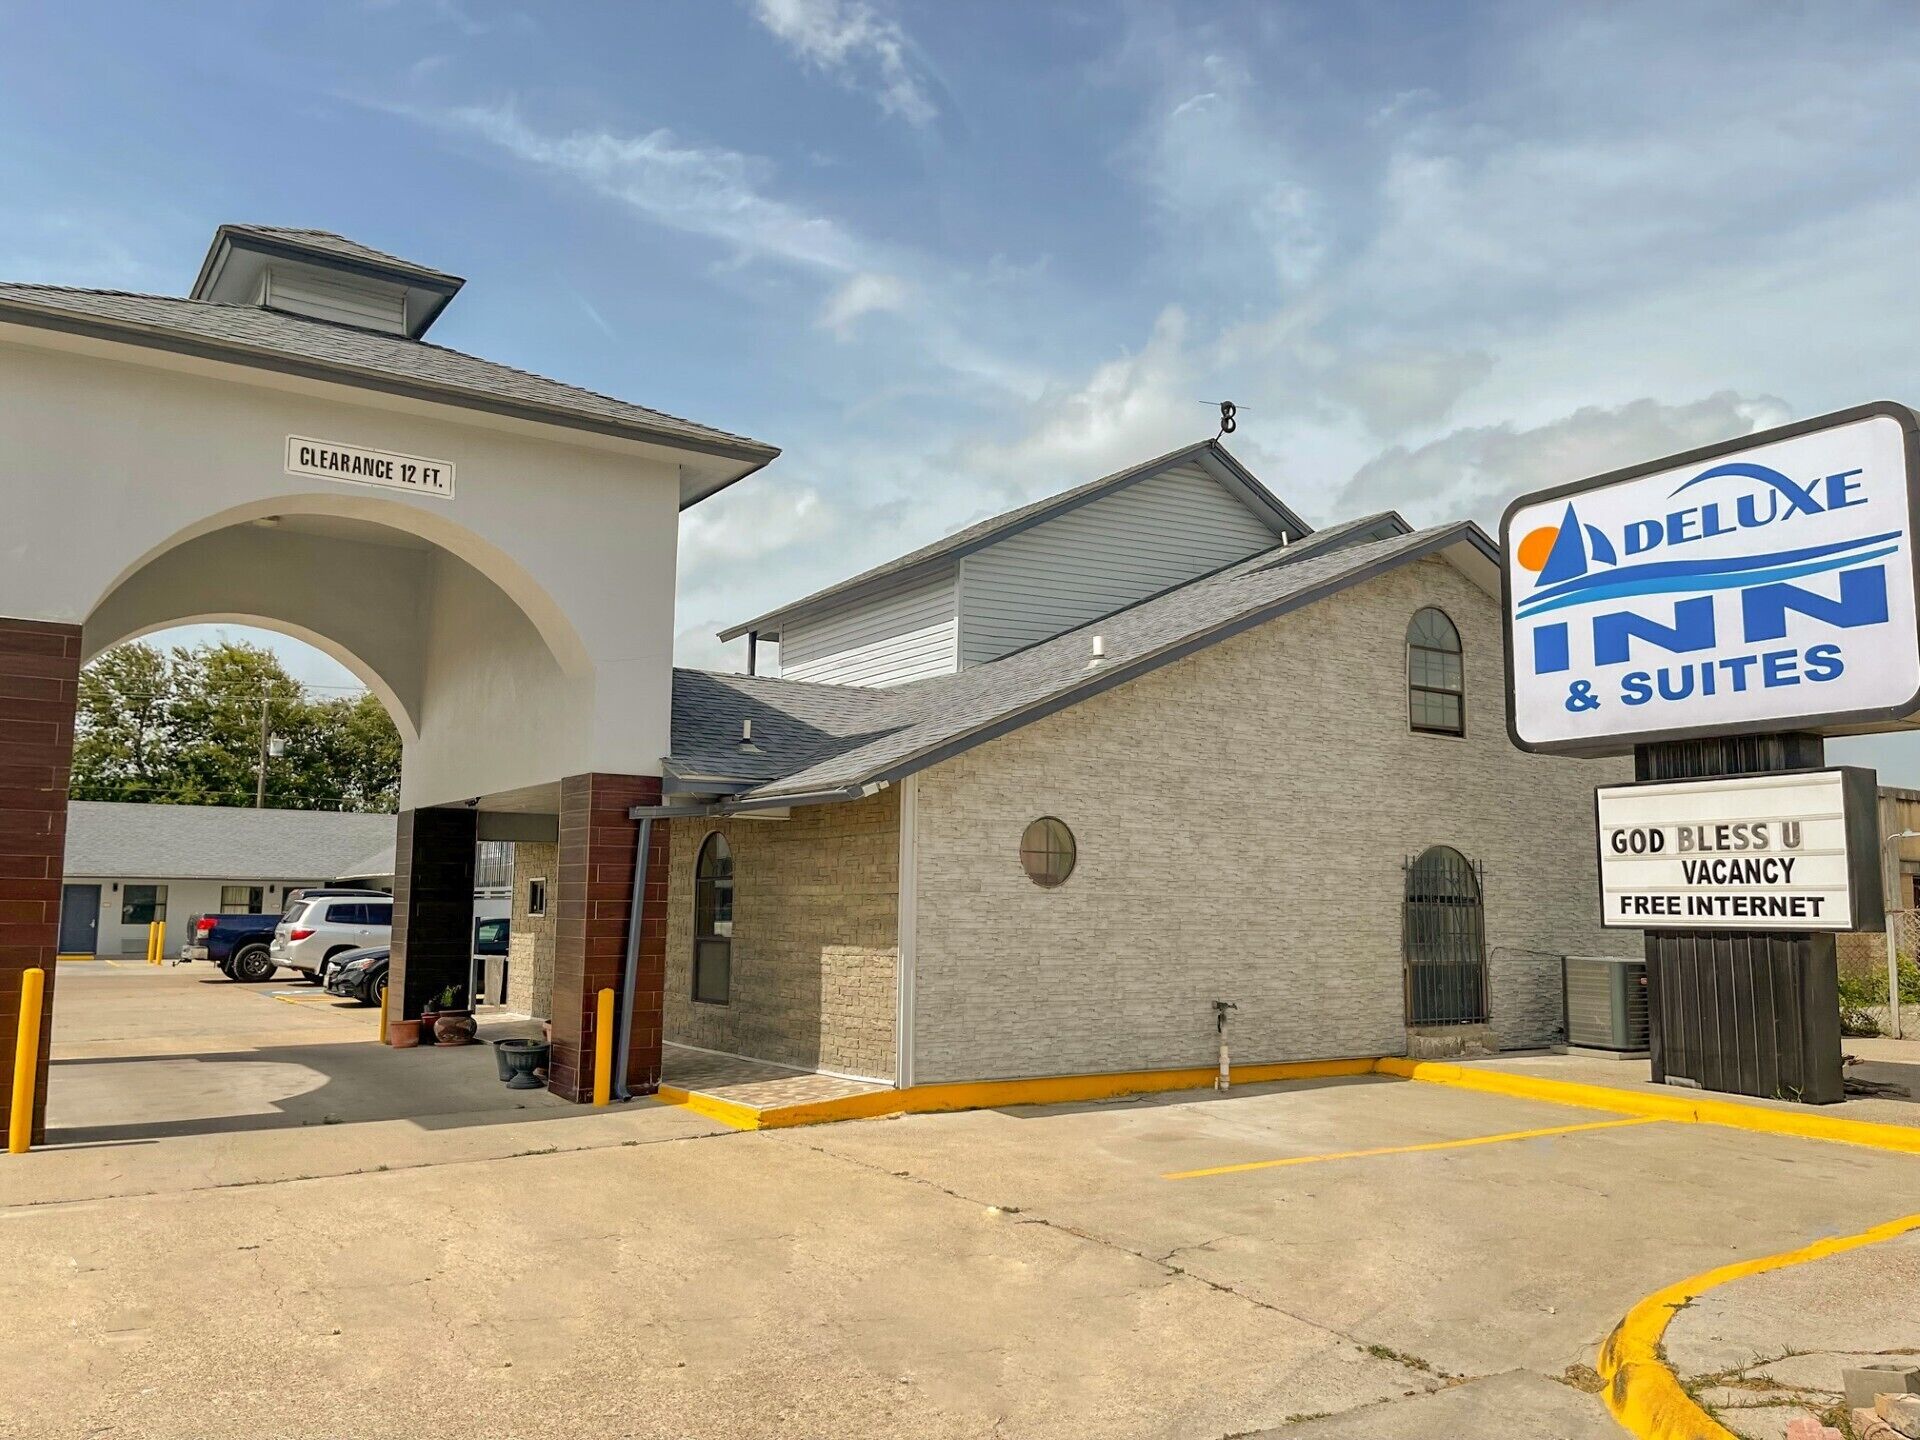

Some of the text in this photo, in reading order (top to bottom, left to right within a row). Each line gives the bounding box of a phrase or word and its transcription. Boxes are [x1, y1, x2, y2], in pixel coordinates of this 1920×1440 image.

[300, 446, 443, 488] CLEARANCE 12 FT.
[1624, 465, 1869, 556] DELUXE
[1533, 564, 1889, 675] INN
[1564, 644, 1845, 713] & SUITES
[1611, 820, 1801, 854] GOD BLESS U
[1682, 857, 1796, 885] VACANCY
[1620, 895, 1825, 917] FREE INTERNET
